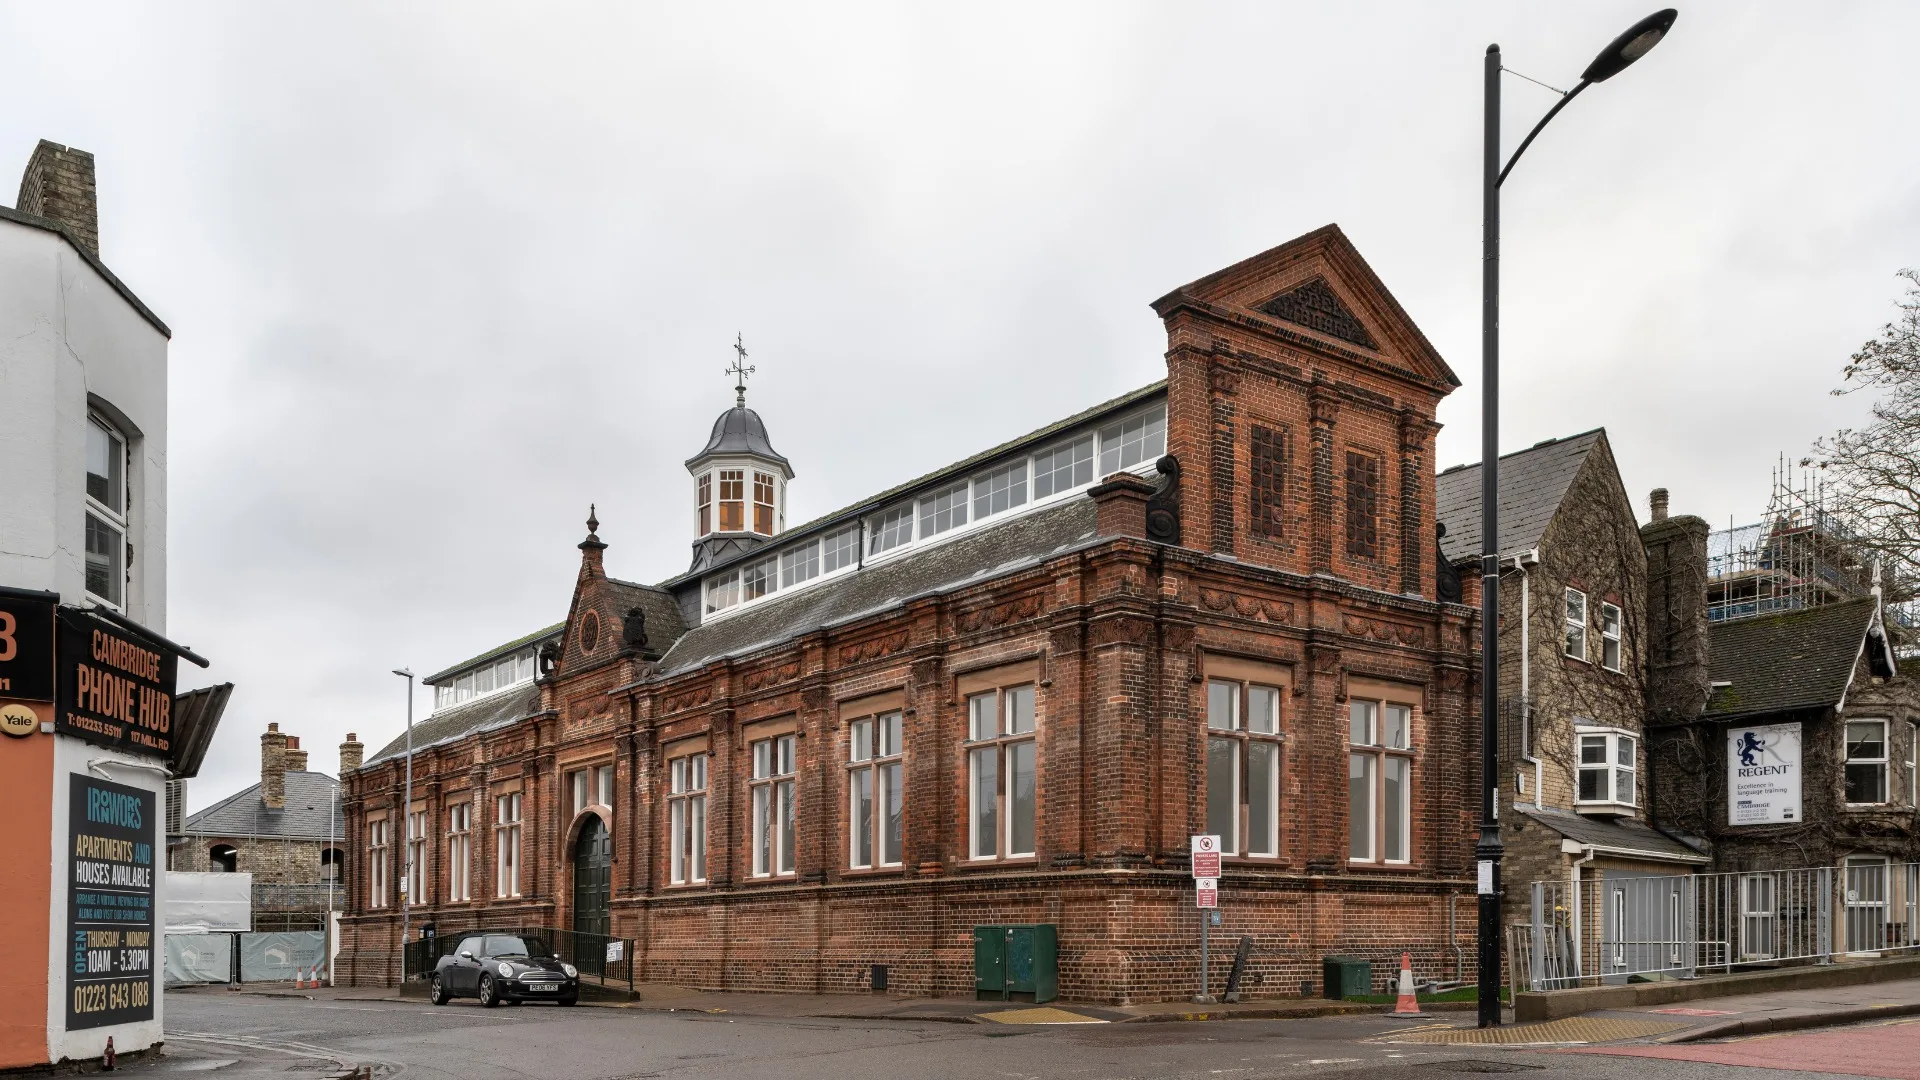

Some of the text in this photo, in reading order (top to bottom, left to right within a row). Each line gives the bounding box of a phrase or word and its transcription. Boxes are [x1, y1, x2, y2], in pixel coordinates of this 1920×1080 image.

[93, 629, 160, 683] CAMBRIDGE
[78, 663, 170, 734] PHONE HUB
[4, 714, 32, 727] Yale
[67, 712, 75, 726] T:
[131, 730, 169, 751] 117 MILL RD
[1738, 765, 1789, 777] REGENT
[76, 834, 150, 865] APARTMENTS AND
[76, 861, 150, 887] HOUSES AVAILABLE
[75, 931, 87, 973] OPEN
[87, 931, 120, 948] THURSDAY
[126, 931, 150, 947] MONDAY
[88, 950, 111, 973] 10AM
[120, 949, 149, 972] 5.30PM
[74, 981, 149, 1014] 01223 643 088
